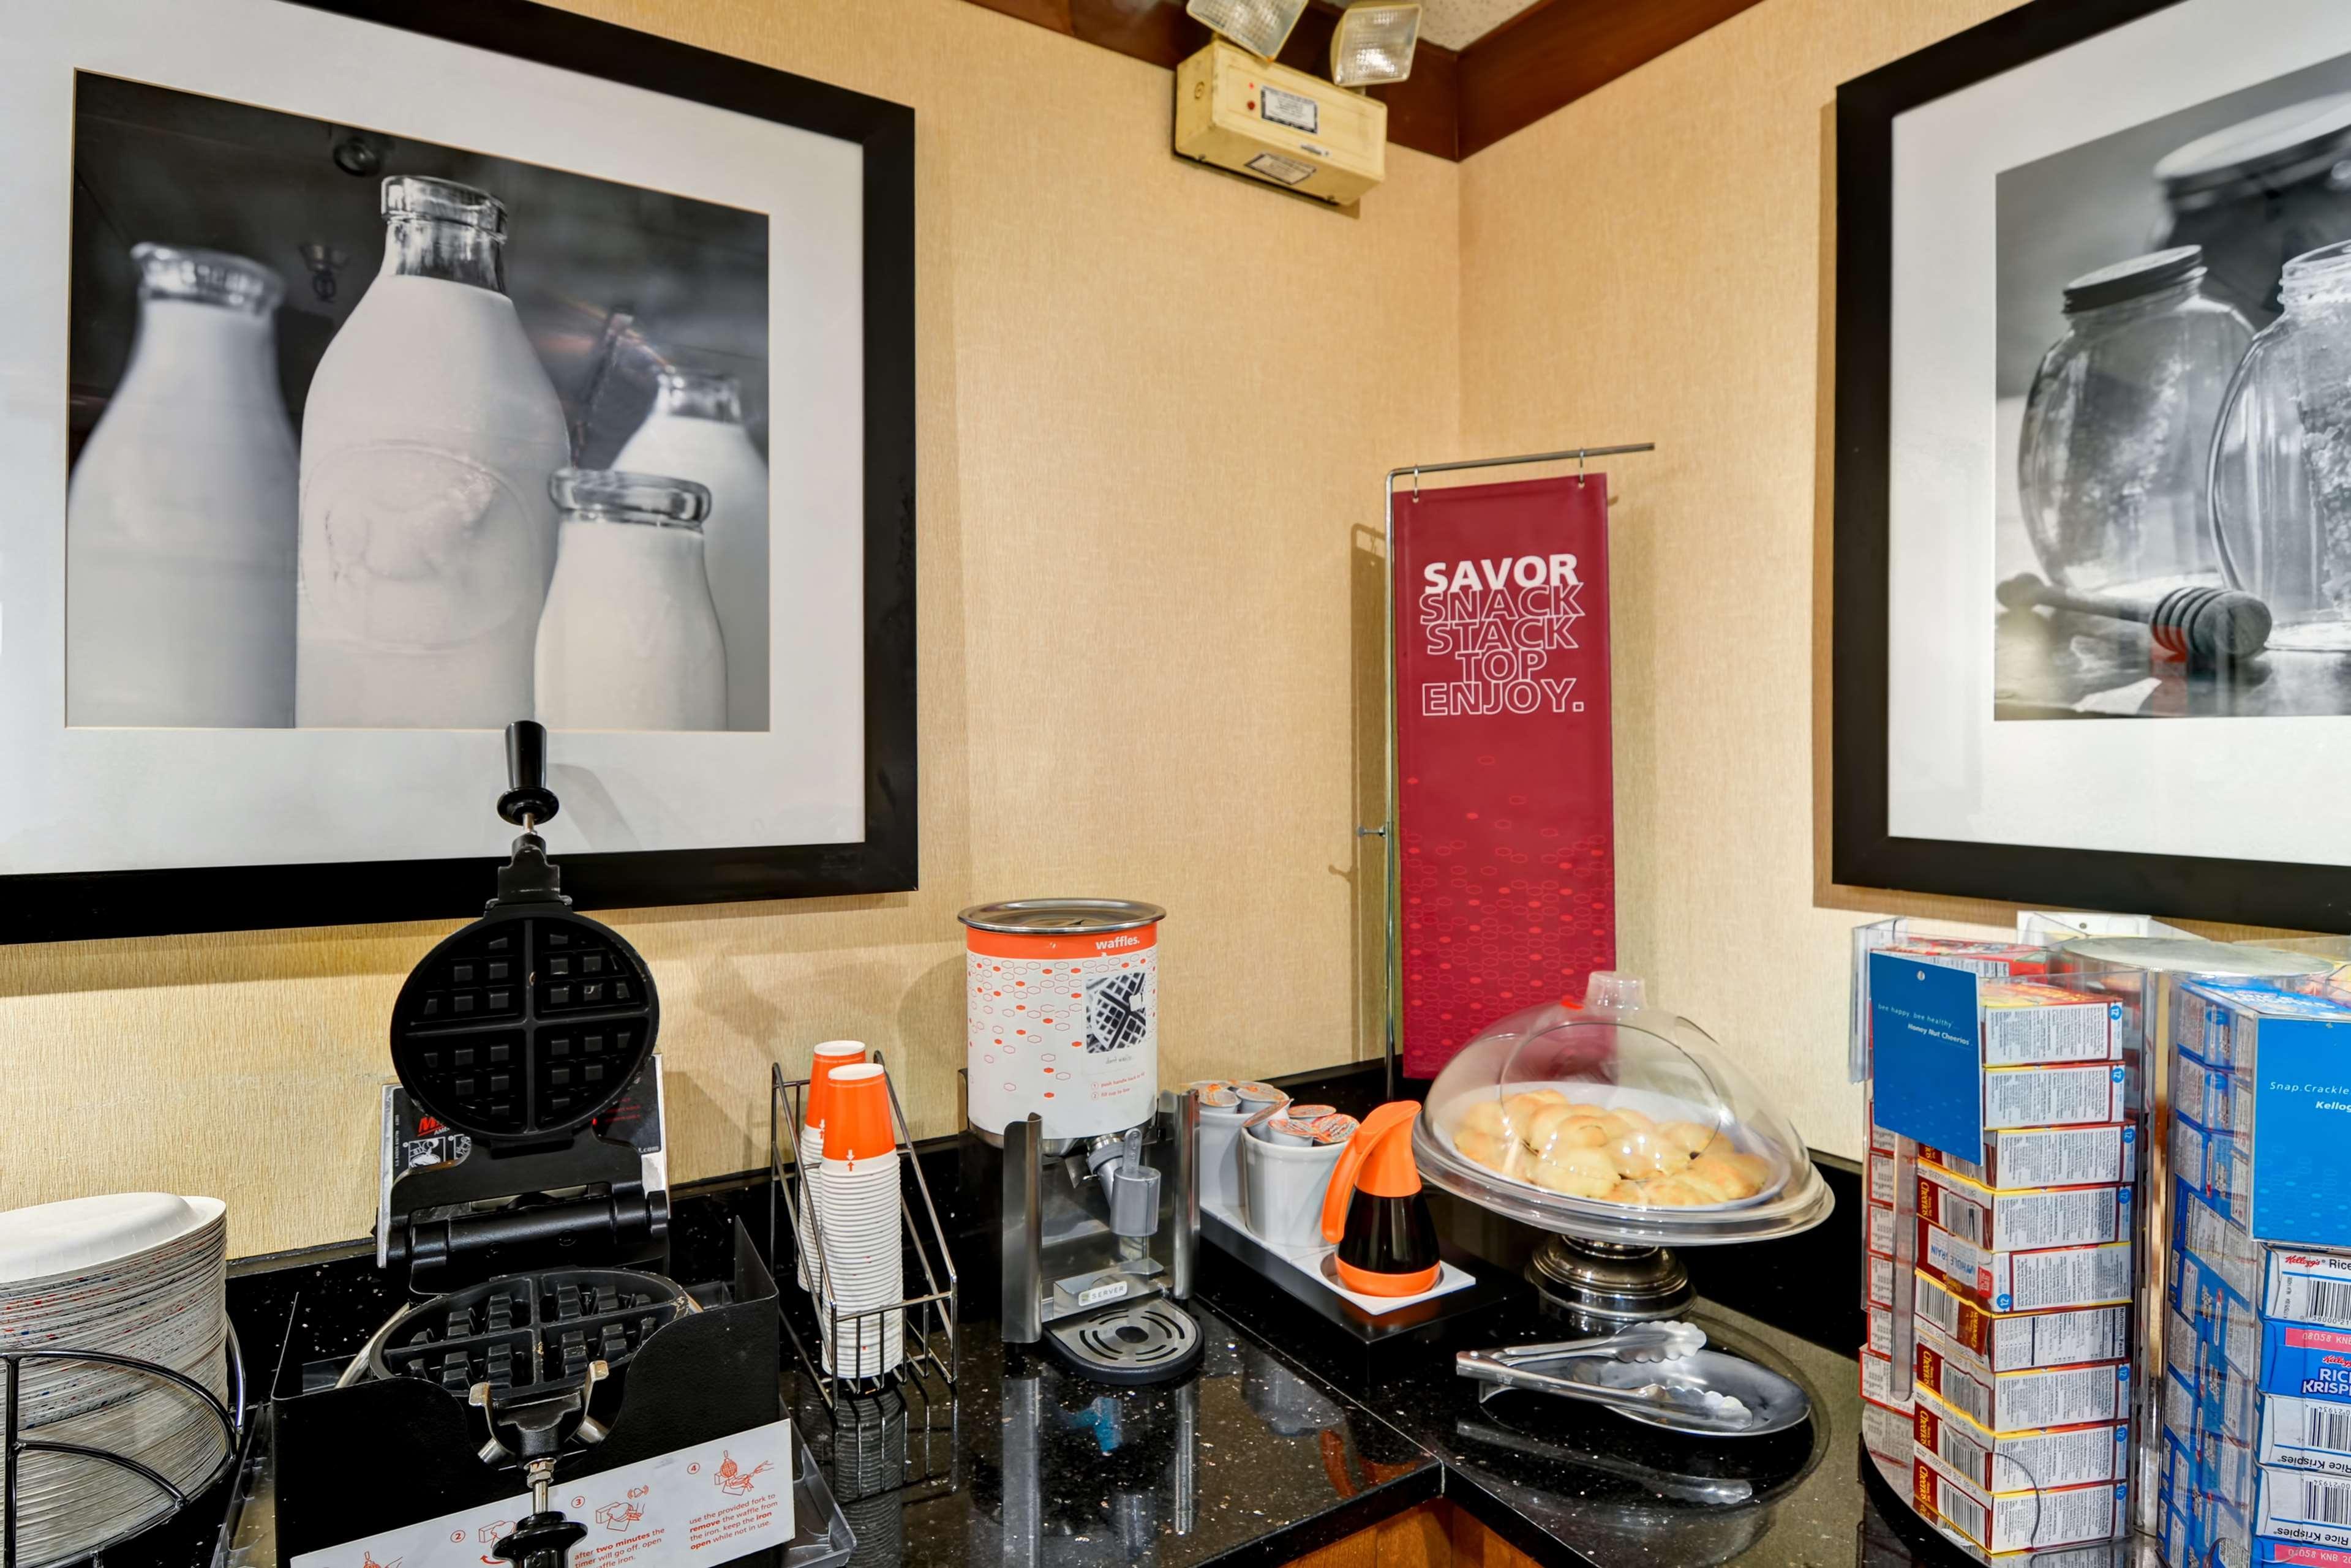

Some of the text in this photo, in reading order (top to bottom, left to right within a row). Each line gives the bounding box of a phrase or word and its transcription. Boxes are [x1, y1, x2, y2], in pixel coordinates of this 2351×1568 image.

[1423, 553, 1578, 593] SAVOR
[1420, 582, 1586, 625] SNACK
[1426, 615, 1579, 655] STACK
[1455, 648, 1547, 683] TOP
[1422, 678, 1584, 716] ENJOY.
[1095, 935, 1140, 950] waffles.
[1931, 1245, 1947, 1261] RAIN
[1092, 1286, 1124, 1299] SERVER
[690, 1520, 720, 1532] remove
[737, 1507, 759, 1518] waffle
[761, 1501, 778, 1510] from
[718, 1501, 750, 1517] provided
[751, 1496, 766, 1505] fork
[723, 1521, 740, 1531] keep
[756, 1512, 772, 1520] iron
[574, 1548, 595, 1560] after
[596, 1544, 613, 1553] two
[615, 1533, 650, 1548] minutes
[690, 1540, 711, 1550] open
[713, 1532, 733, 1543] while
[735, 1528, 747, 1536] not
[2325, 1534, 2349, 1546] Rice
[575, 1558, 596, 1568] timer
[598, 1553, 612, 1562] will
[614, 1550, 625, 1558] go
[642, 1538, 662, 1549] open
[2320, 1553, 2338, 1561] KNB
